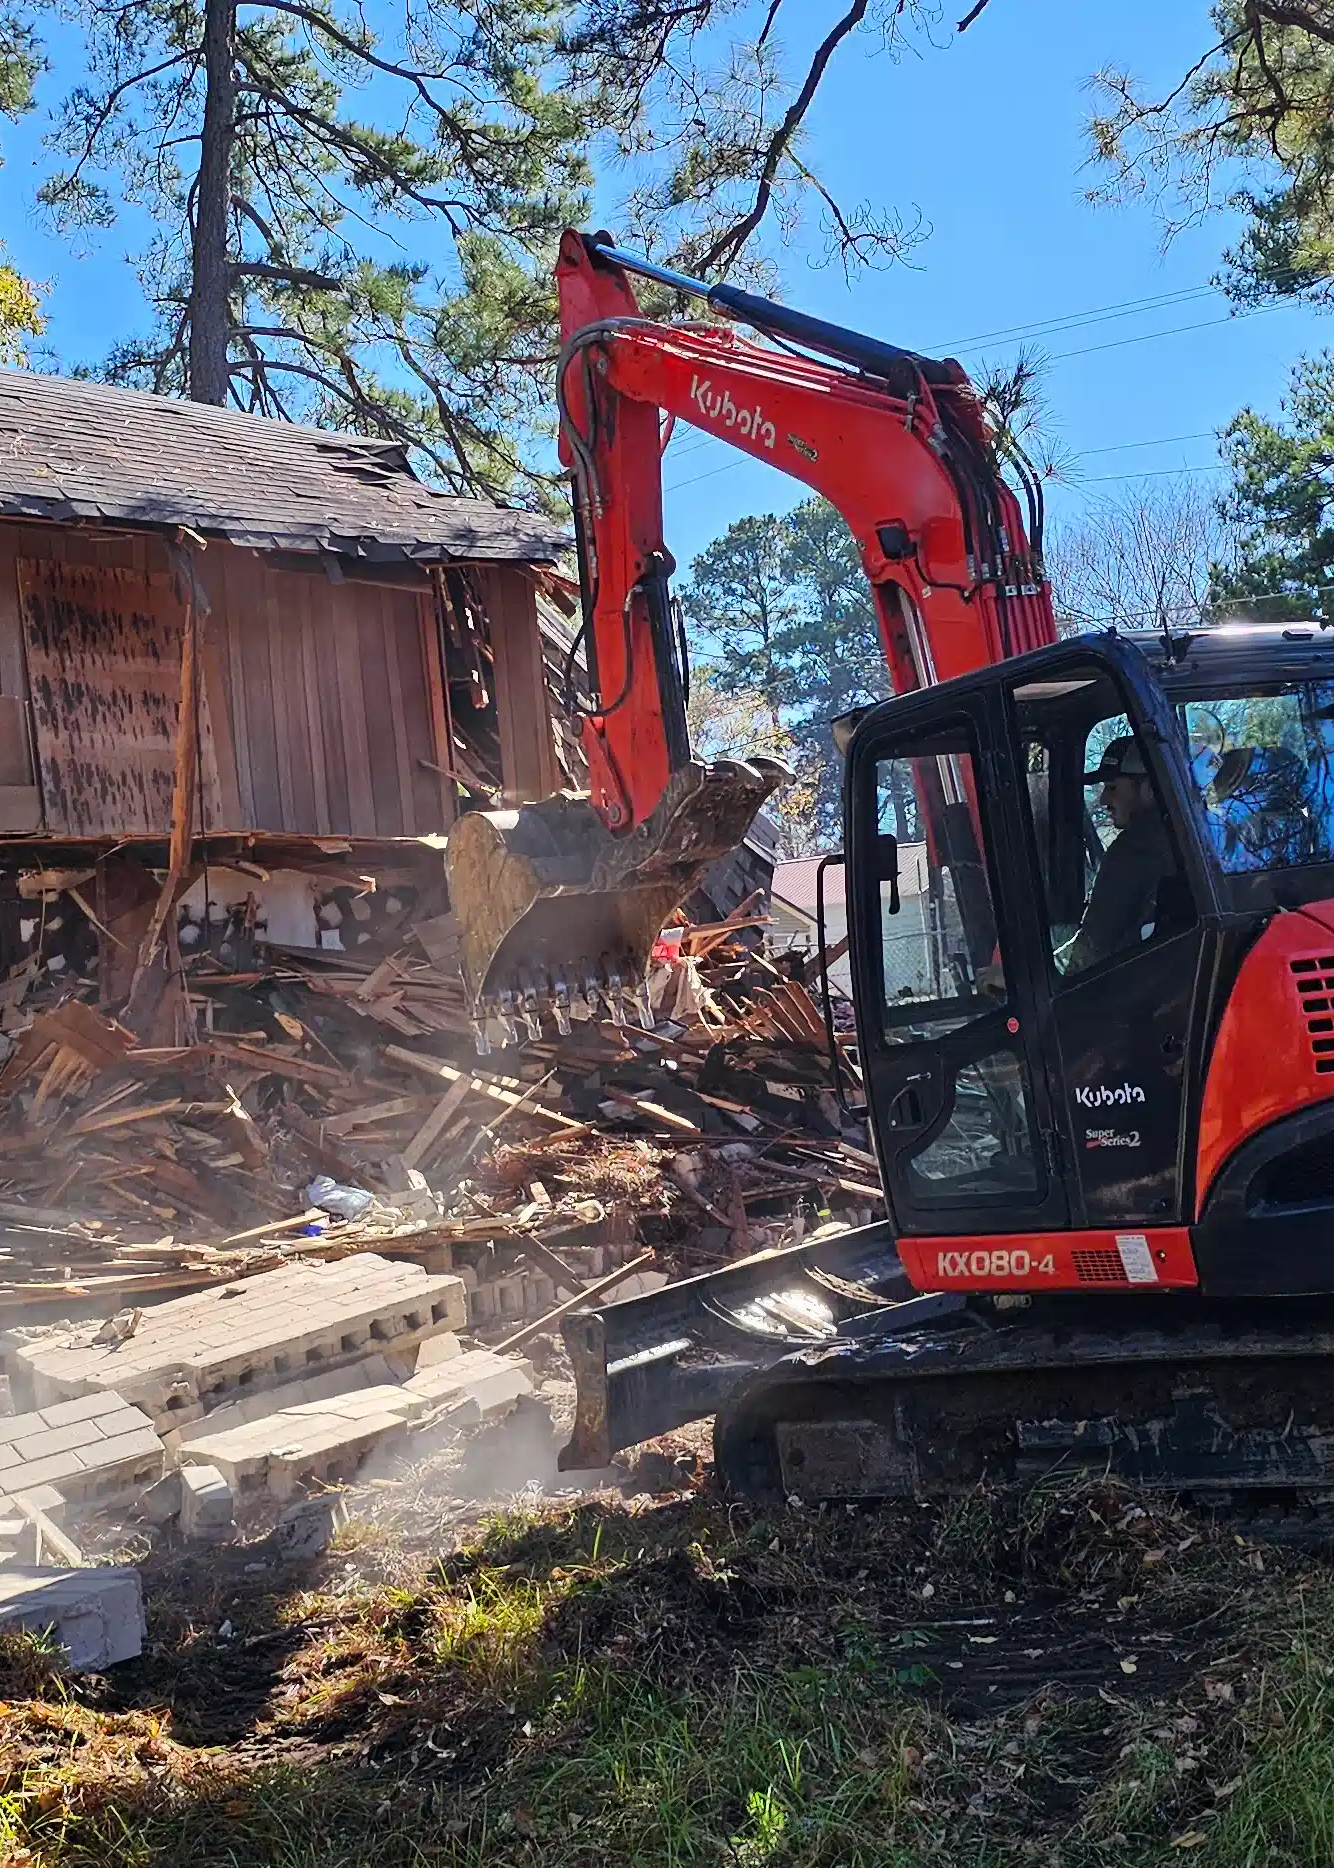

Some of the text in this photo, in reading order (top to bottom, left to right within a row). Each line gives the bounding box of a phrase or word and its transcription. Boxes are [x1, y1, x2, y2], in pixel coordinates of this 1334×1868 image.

[690, 374, 776, 448] Kubota
[1075, 1082, 1146, 1107] Kubota
[1085, 1129, 1115, 1140] Super
[937, 1250, 1056, 1277] KX080-4
